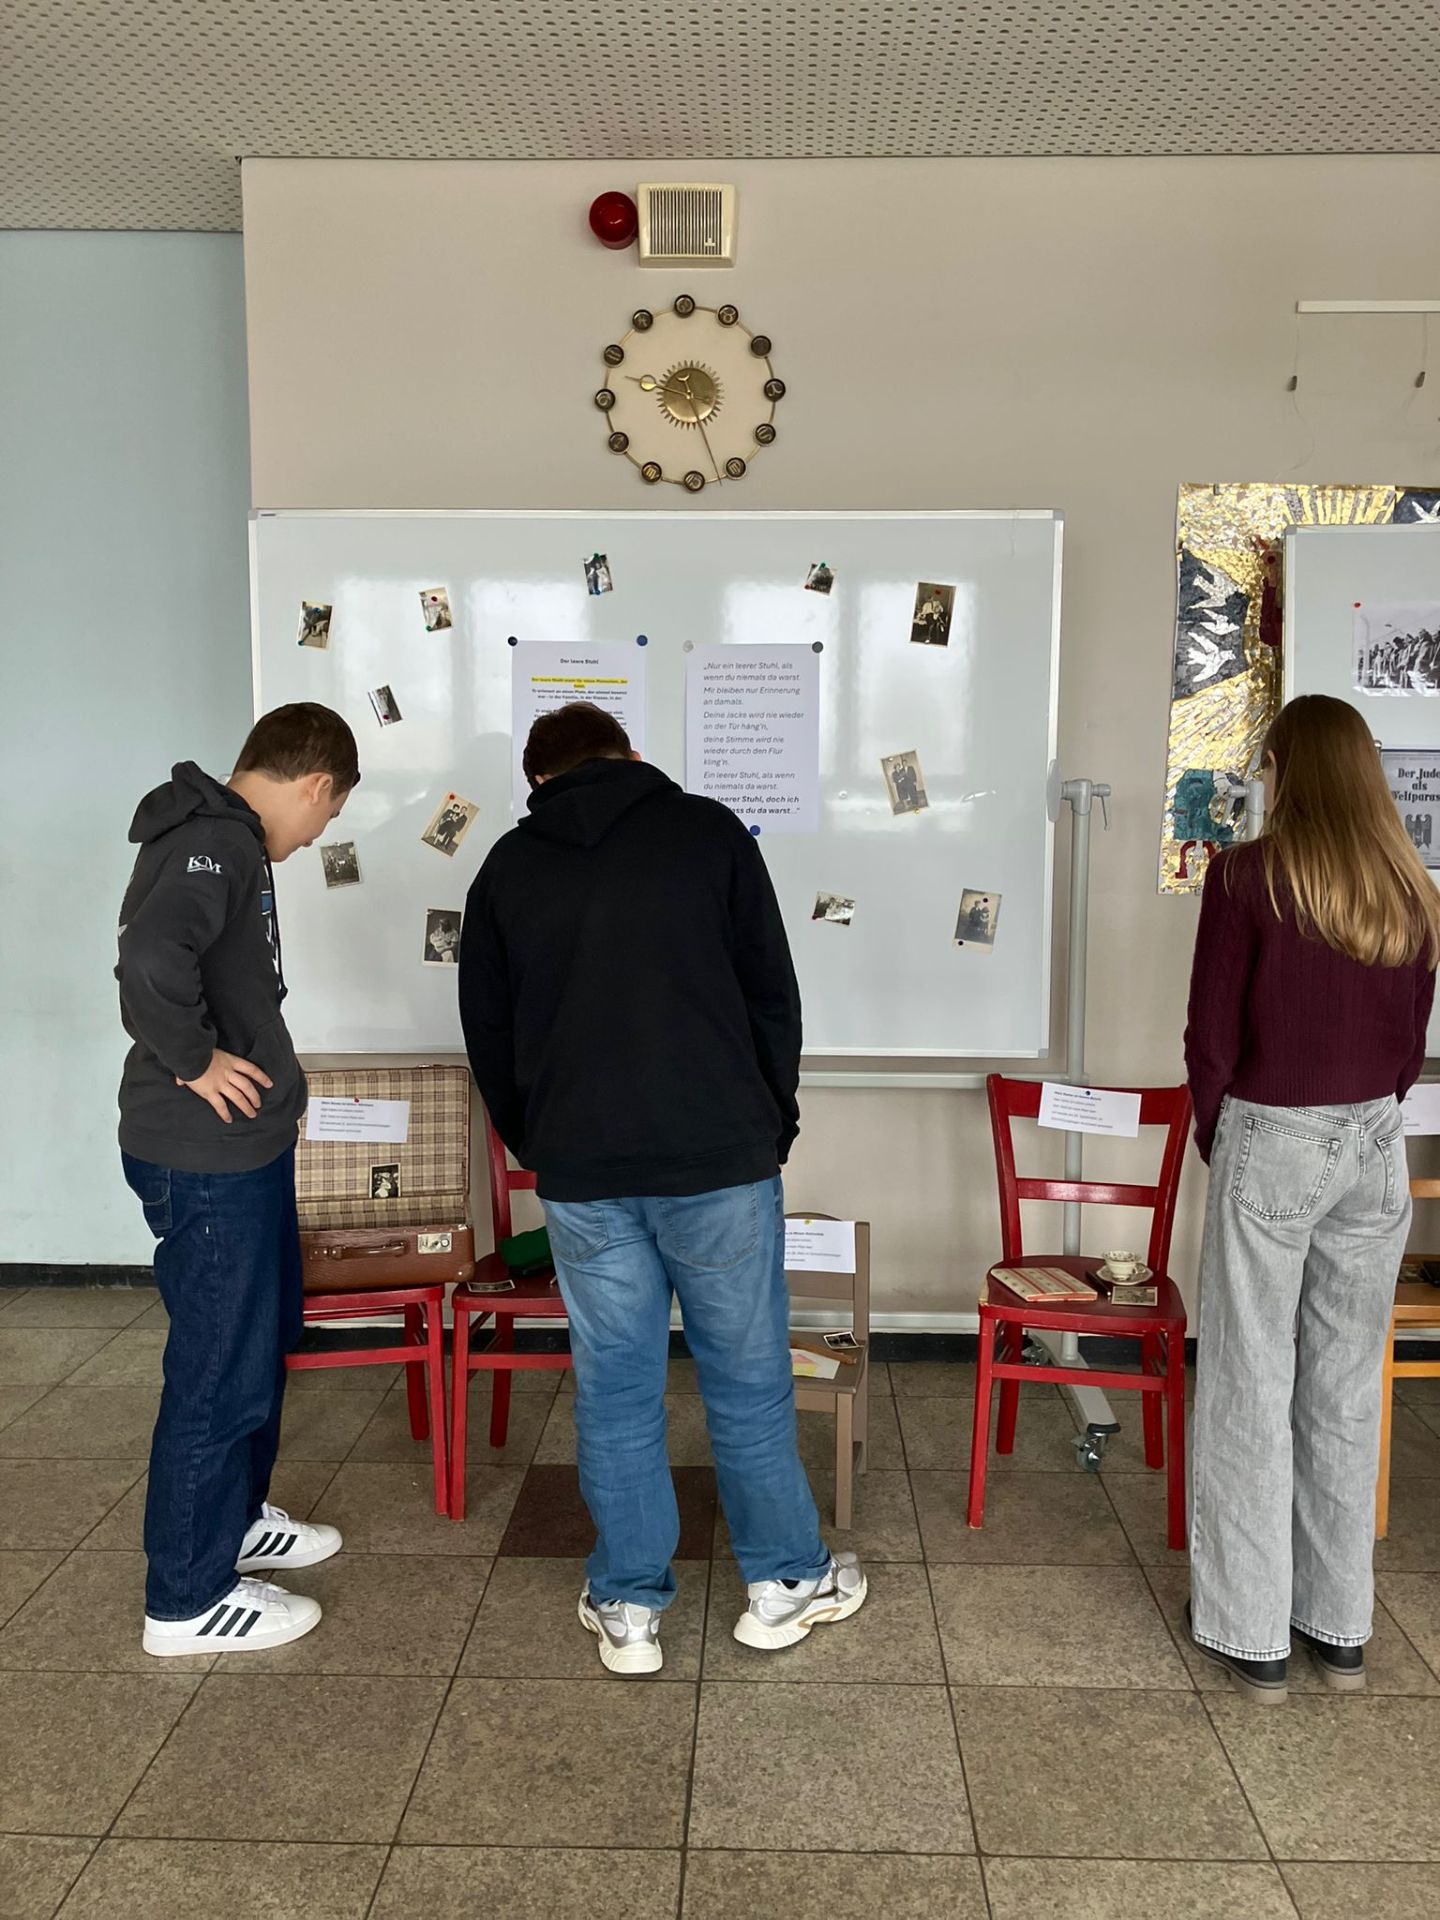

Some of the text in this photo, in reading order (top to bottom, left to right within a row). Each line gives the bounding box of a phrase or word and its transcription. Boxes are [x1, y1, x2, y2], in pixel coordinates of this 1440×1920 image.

[759, 662, 780, 670] Stuhl,
[759, 687, 800, 696] Erinnerung
[726, 711, 747, 719] Jacke
[748, 711, 765, 719] wird
[728, 722, 740, 730] Tür
[730, 747, 751, 755] durch
[704, 771, 715, 779] Ein
[716, 771, 738, 779] leerer
[739, 771, 760, 780] Stuhl,
[1398, 768, 1416, 779] Der
[1412, 781, 1428, 791] als
[741, 796, 764, 804] Stuhl,
